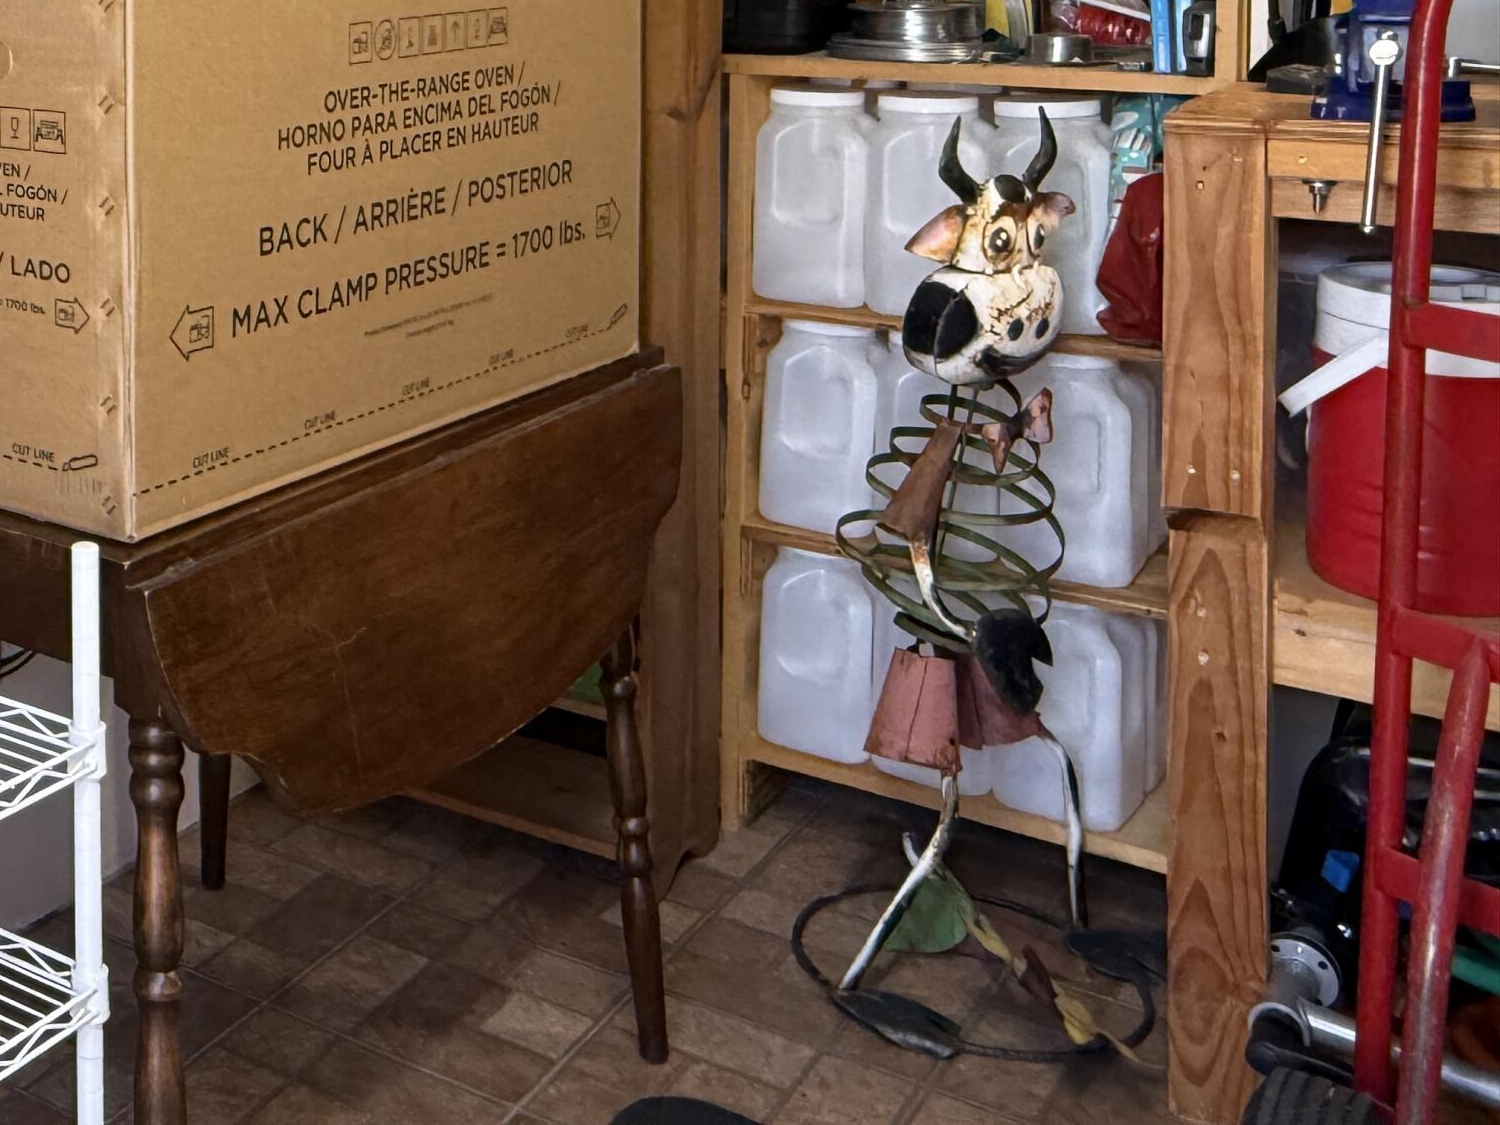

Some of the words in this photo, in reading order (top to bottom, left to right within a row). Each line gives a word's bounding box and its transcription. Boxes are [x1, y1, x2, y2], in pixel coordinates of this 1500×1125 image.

[324, 71, 471, 113] OVER-THE-RANGE
[474, 63, 514, 89] OVEN
[518, 60, 525, 87] /
[278, 119, 346, 151] HORNO
[351, 110, 398, 139] PARA
[403, 99, 463, 129] ENCIMA
[468, 94, 496, 118] DEL
[500, 82, 550, 112] FOGÓN
[554, 80, 562, 107] /
[308, 146, 356, 176] FOUR
[361, 139, 374, 167] À
[380, 130, 442, 162] PLACER
[447, 125, 466, 148] EN
[471, 112, 539, 144] HAUTEUR
[7, 183, 57, 203] FOGÓN
[61, 188, 68, 205] /
[23, 164, 31, 181] /
[260, 213, 329, 257] BACK
[333, 205, 347, 244] /
[353, 186, 446, 235] ARRIÈRE
[451, 179, 463, 217] /
[468, 160, 572, 207] POSTERIOR
[11, 255, 72, 284] LADO
[232, 295, 289, 338] MAX
[297, 272, 378, 319] CLAMP
[385, 241, 490, 295] PRESSURE
[512, 225, 553, 259] 1700
[559, 220, 586, 246] lbs.
[12, 443, 30, 456] CUT
